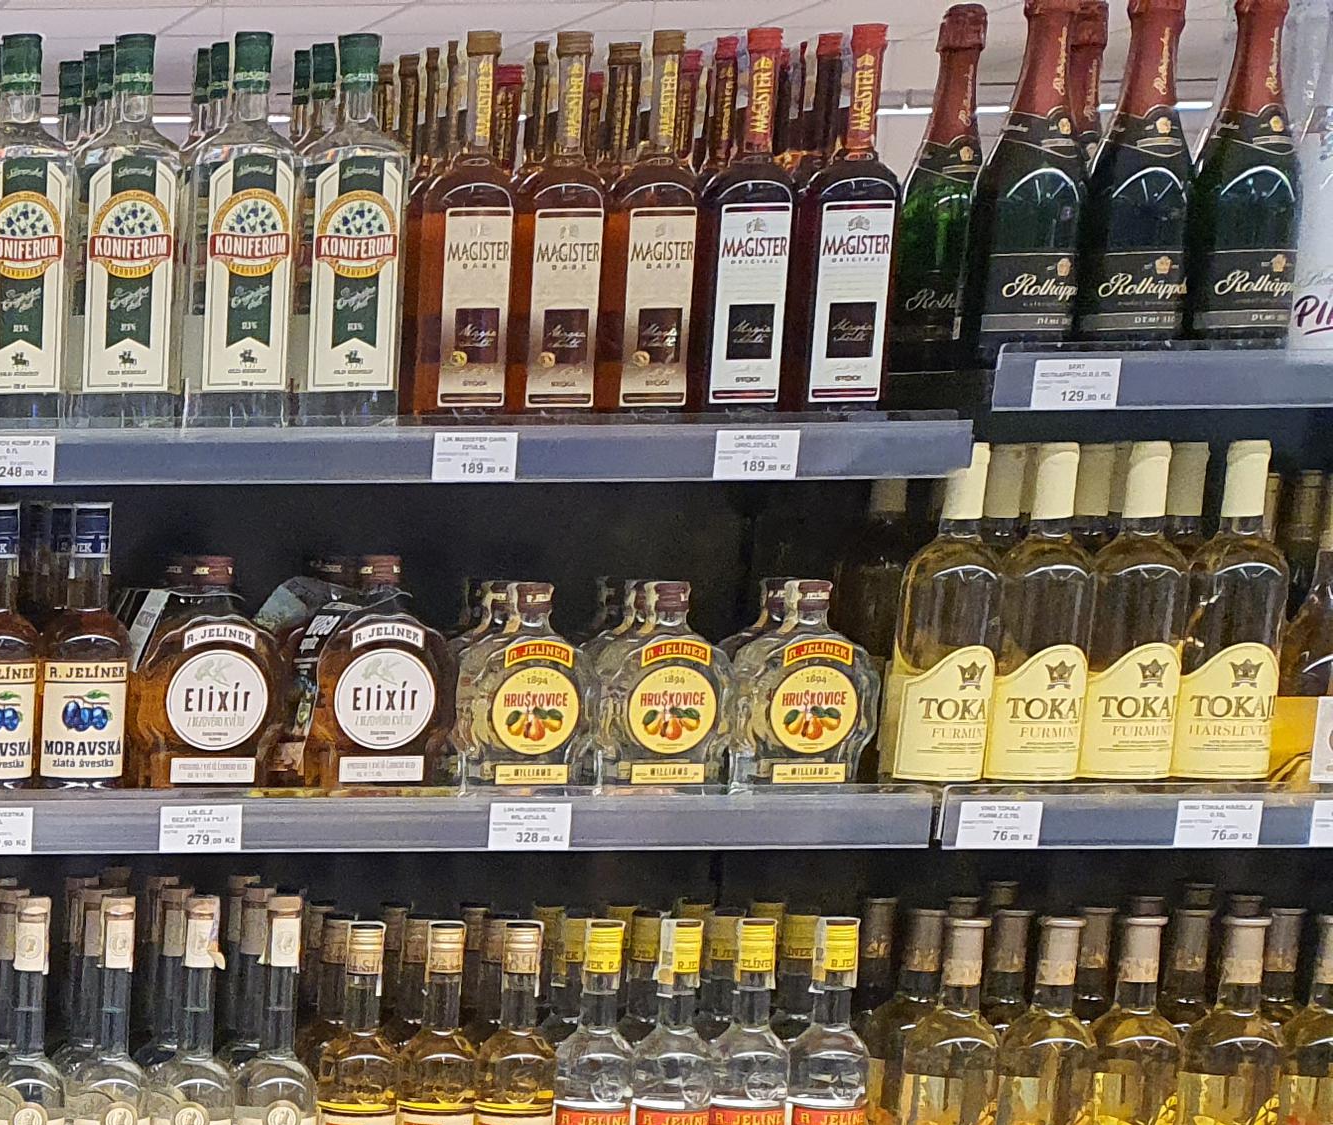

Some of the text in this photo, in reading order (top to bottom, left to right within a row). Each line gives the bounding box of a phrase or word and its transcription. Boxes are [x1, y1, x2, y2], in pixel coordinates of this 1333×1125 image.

[95, 236, 168, 260] KONIFERUM
[215, 234, 287, 258] KONIFERUM
[320, 235, 393, 259] KONIFERUM
[448, 242, 509, 261] MAGISTER
[536, 242, 599, 263] MAGISTER
[631, 241, 694, 262] MAGISTER
[722, 237, 787, 257] MAGISTER
[823, 234, 889, 255] MAGISTER
[184, 683, 250, 713] Elixír
[352, 681, 419, 711] Elixír
[503, 688, 569, 707] HRUŠKOVICE
[640, 687, 705, 707] HRUŠKOVICE
[782, 687, 847, 706] HRUŠKOVICE
[44, 737, 121, 757] MORAVSKÁ
[513, 767, 552, 777] WILLIAMS
